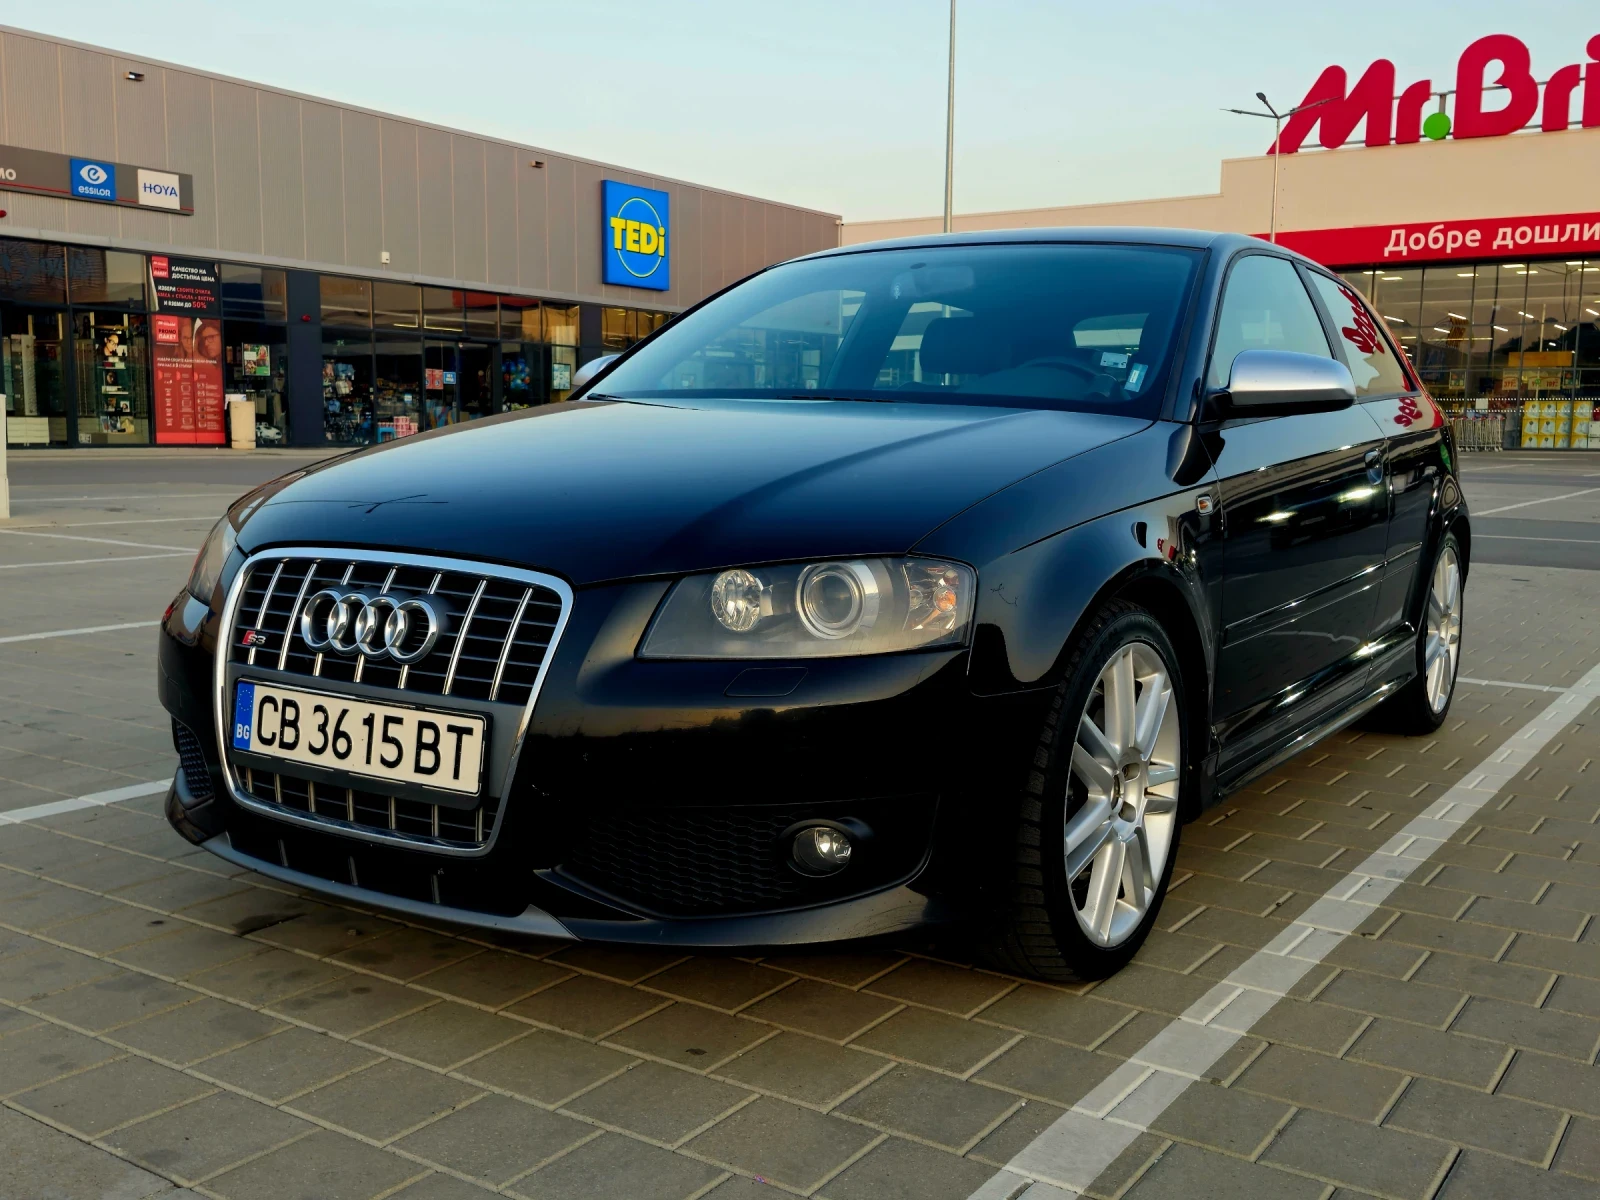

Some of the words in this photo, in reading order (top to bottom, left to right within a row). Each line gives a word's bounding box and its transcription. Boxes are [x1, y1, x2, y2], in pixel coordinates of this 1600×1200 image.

[142, 183, 178, 197] HOYA
[610, 216, 666, 257] TEDi
[1384, 224, 1481, 257] Добре
[1492, 222, 1600, 249] дошли
[171, 273, 200, 281] ДОСТЪПНА
[192, 301, 207, 309] 50%
[248, 633, 266, 645] S3
[236, 723, 250, 740] BG
[257, 695, 301, 751] CB
[308, 704, 404, 769] 3615
[414, 720, 474, 780] BT
